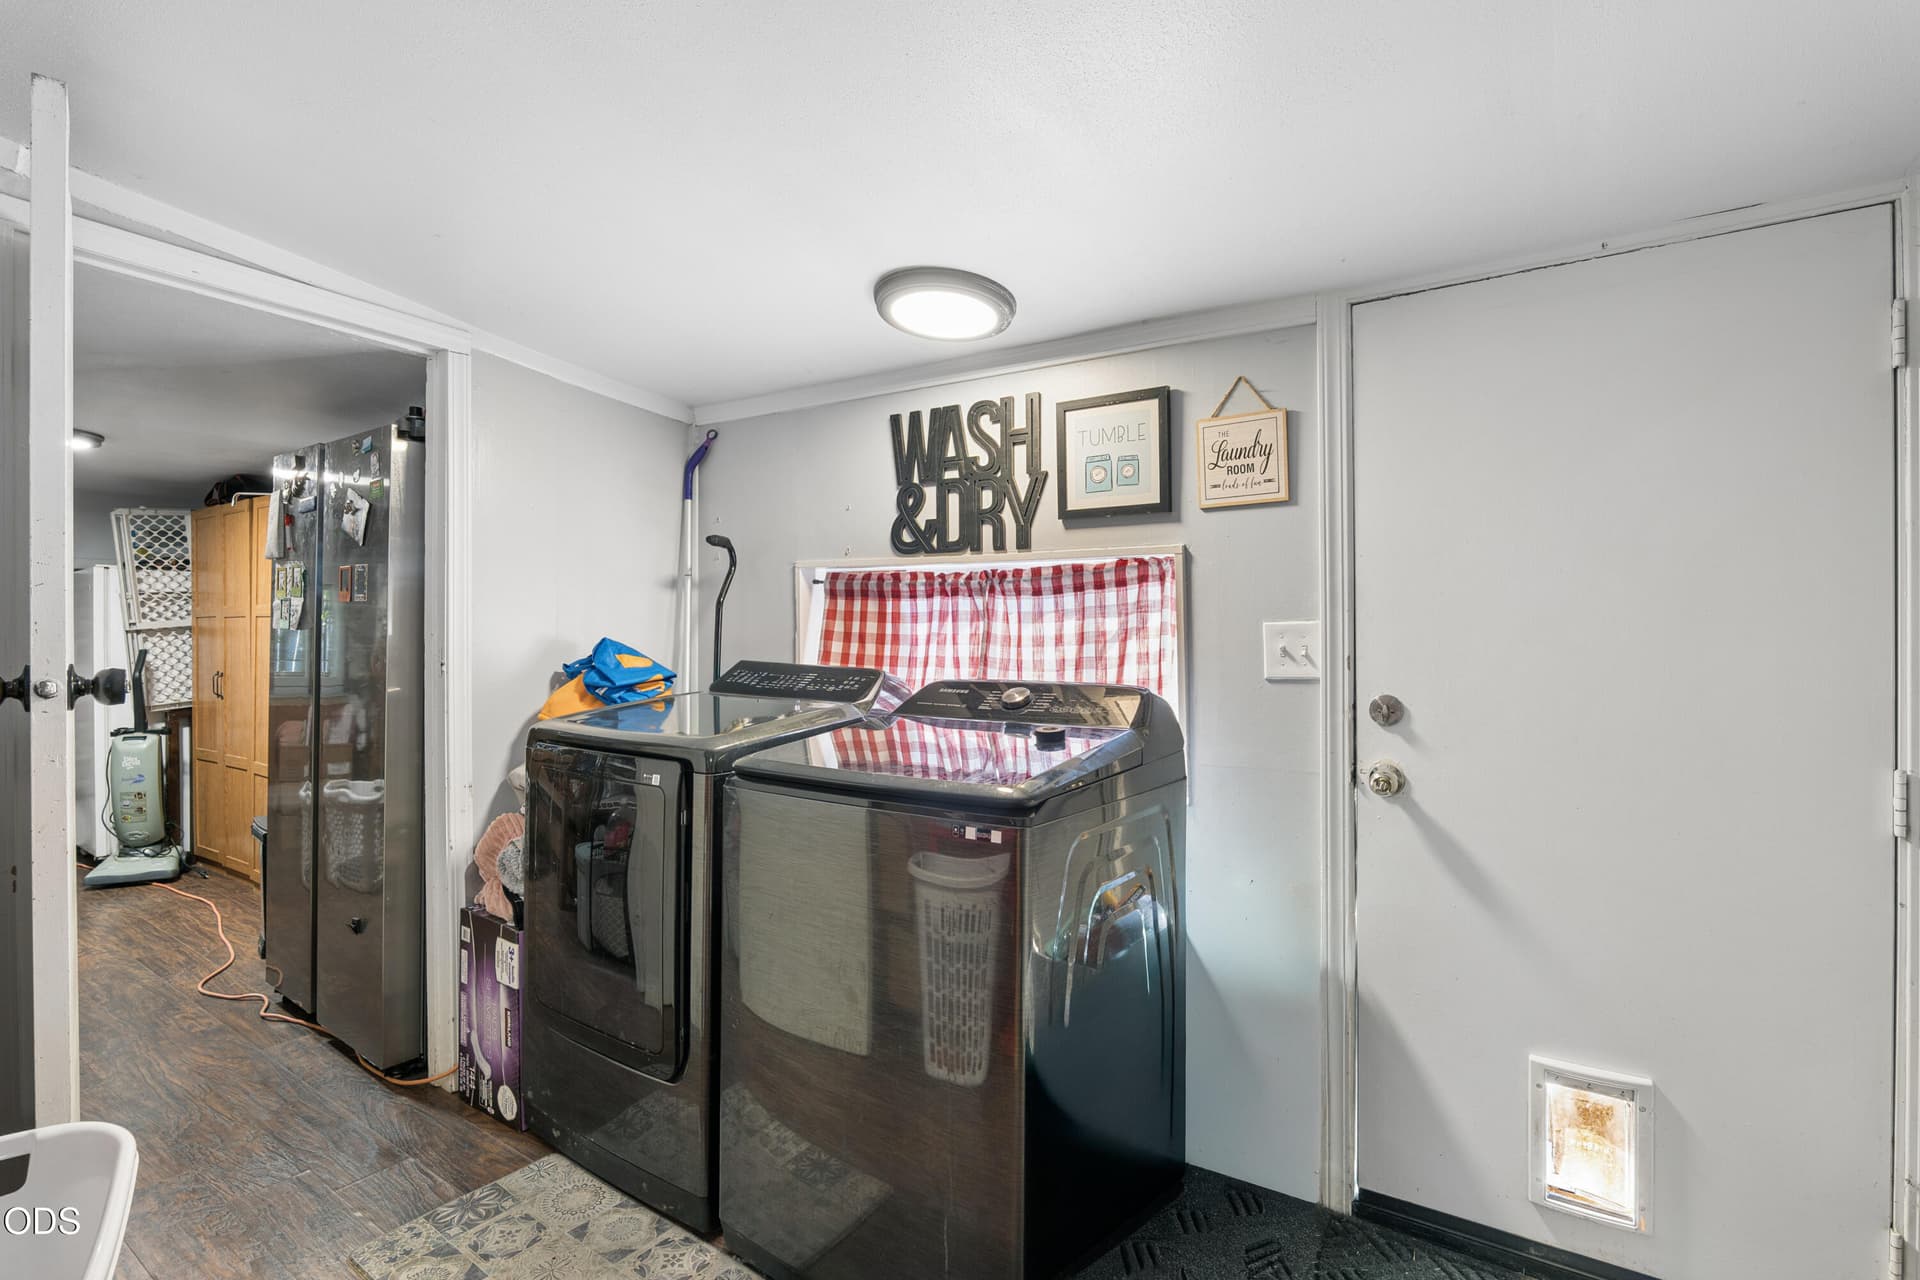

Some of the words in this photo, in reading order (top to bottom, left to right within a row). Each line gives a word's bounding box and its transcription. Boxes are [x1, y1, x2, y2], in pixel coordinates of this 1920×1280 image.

[890, 392, 1041, 486] WASH
[1078, 422, 1146, 448] TUMBLE
[1208, 429, 1273, 475] Laundry
[1226, 463, 1255, 476] ROOM
